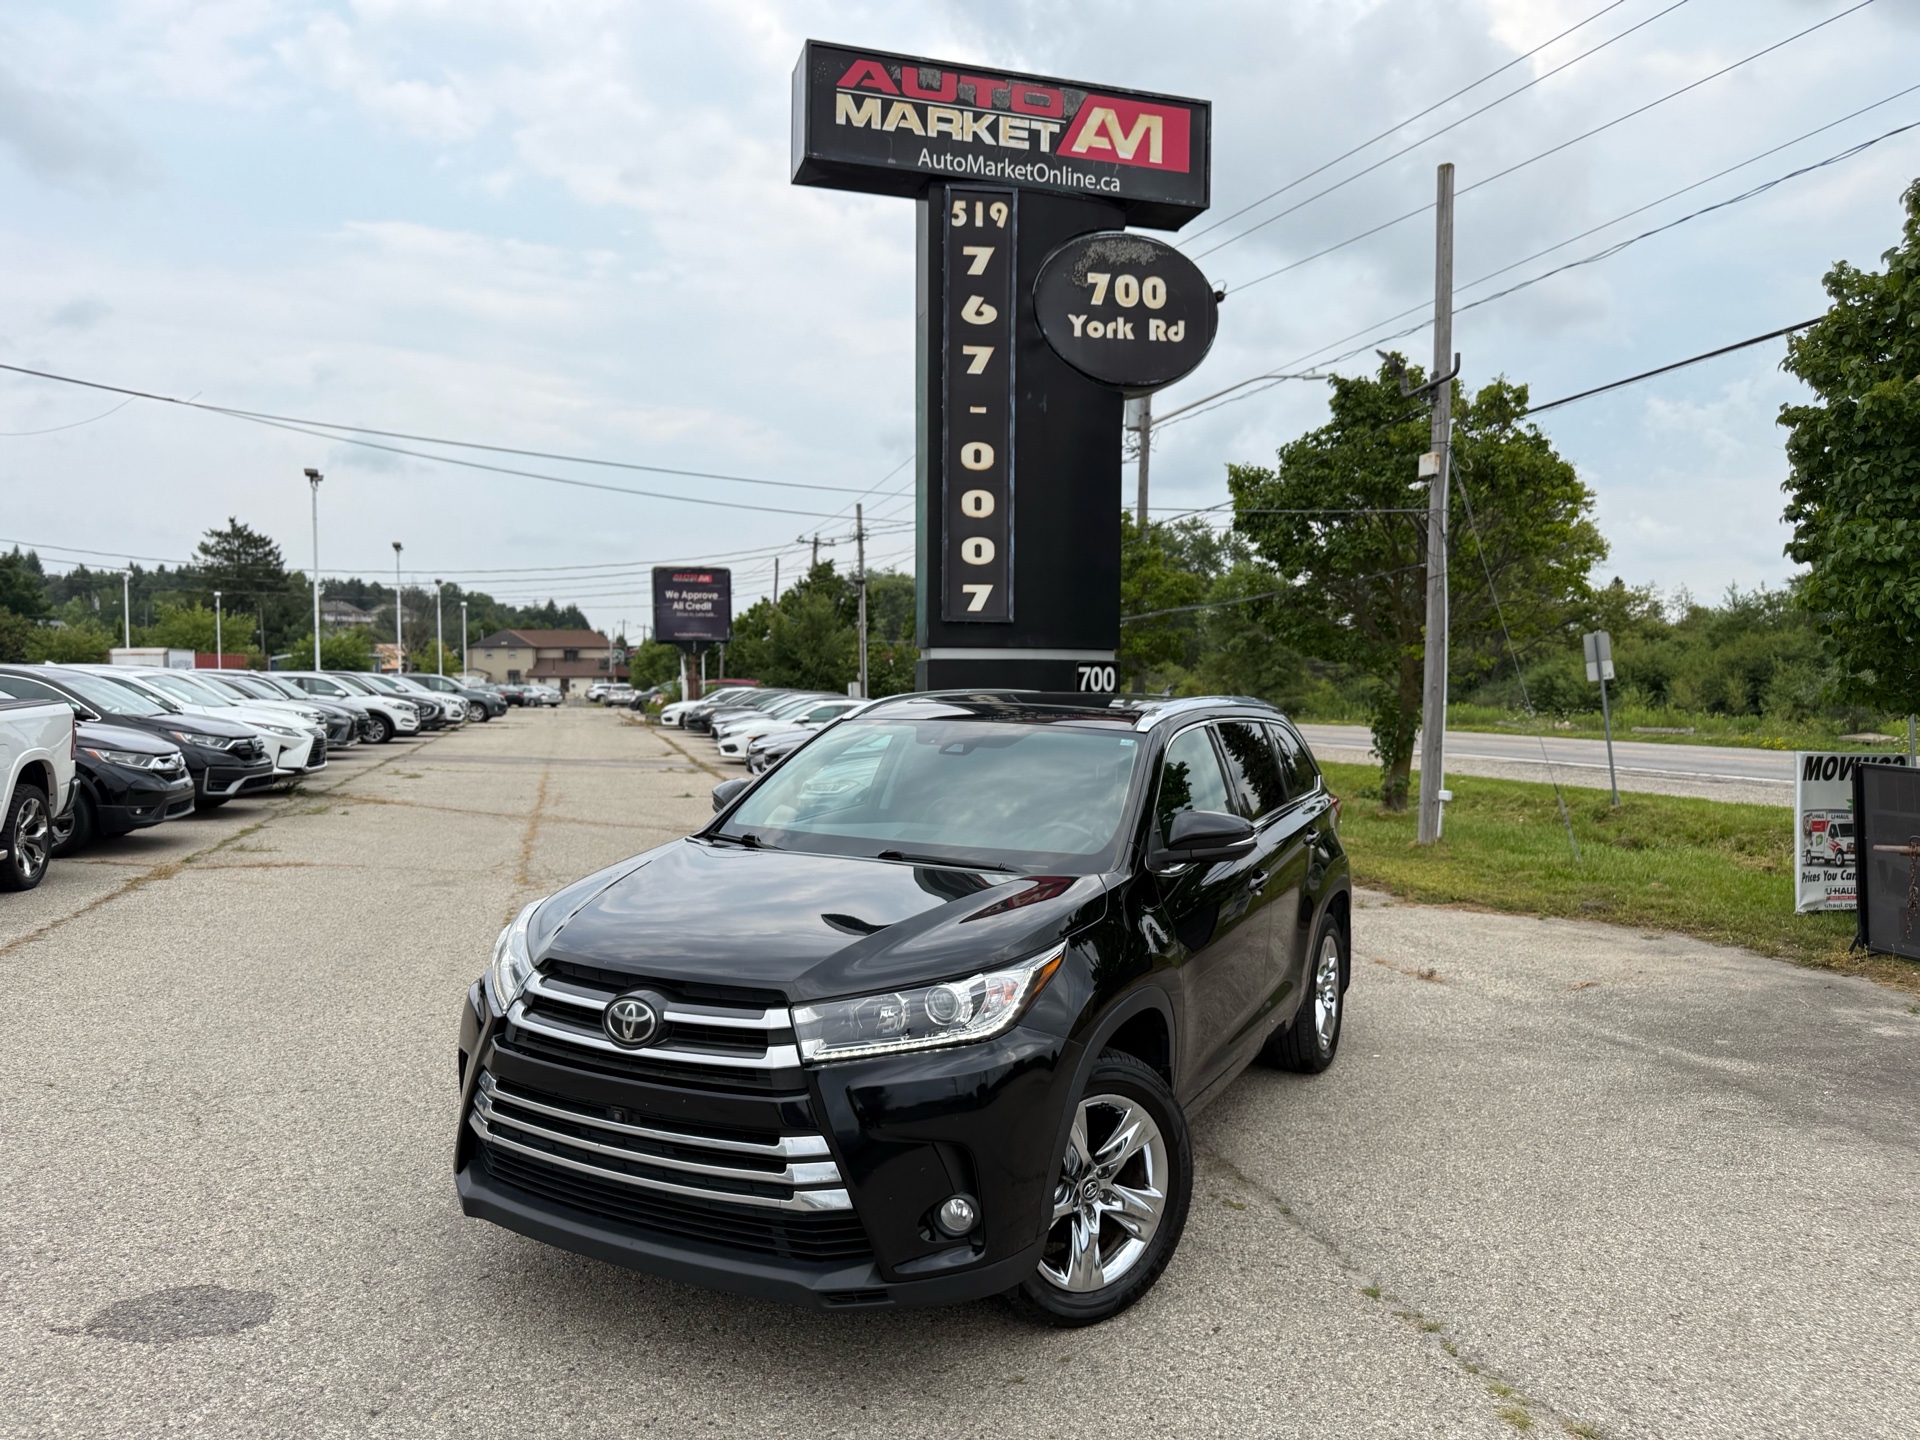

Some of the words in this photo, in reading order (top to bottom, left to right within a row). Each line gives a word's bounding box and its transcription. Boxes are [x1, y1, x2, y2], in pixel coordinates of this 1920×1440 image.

[836, 59, 1065, 118] AUTO
[835, 94, 1060, 153] MARKET
[917, 147, 1121, 192] AutoMarketOnline.ca
[951, 200, 1009, 229] 519
[1086, 272, 1168, 309] 700
[1067, 314, 1136, 340] York
[1148, 318, 1186, 343] Rd
[665, 590, 680, 600] We
[681, 590, 719, 601] Approve
[672, 601, 684, 610] All
[685, 601, 712, 611] Credit
[1078, 666, 1116, 692] 700
[1801, 870, 1821, 883] Prices
[1823, 869, 1838, 881] You
